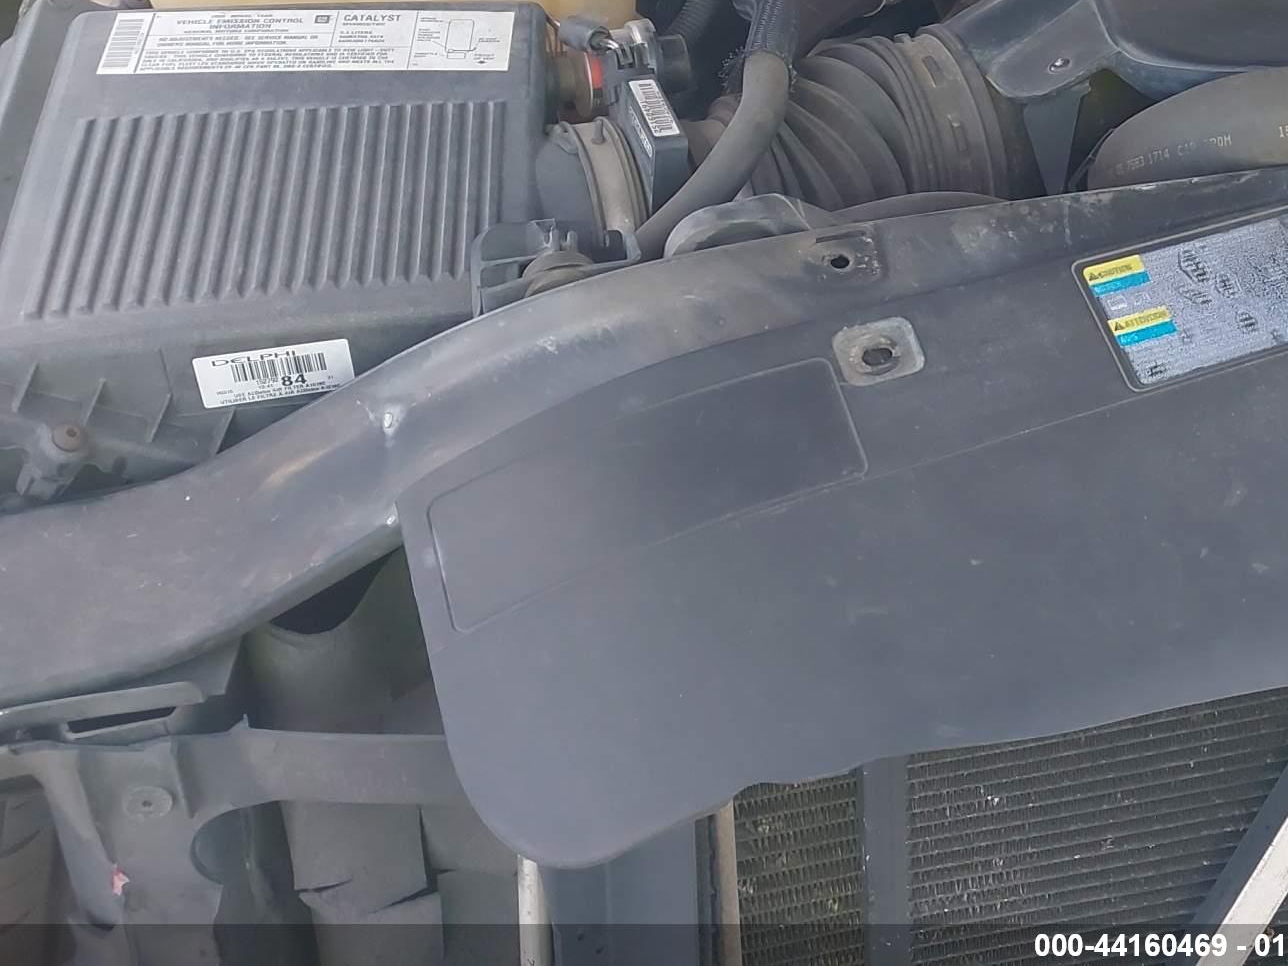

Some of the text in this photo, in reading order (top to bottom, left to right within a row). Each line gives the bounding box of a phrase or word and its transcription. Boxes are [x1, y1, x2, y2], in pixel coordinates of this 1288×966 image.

[343, 14, 401, 22] CATALYST
[211, 350, 296, 367] DELPHI
[281, 373, 307, 387] 84
